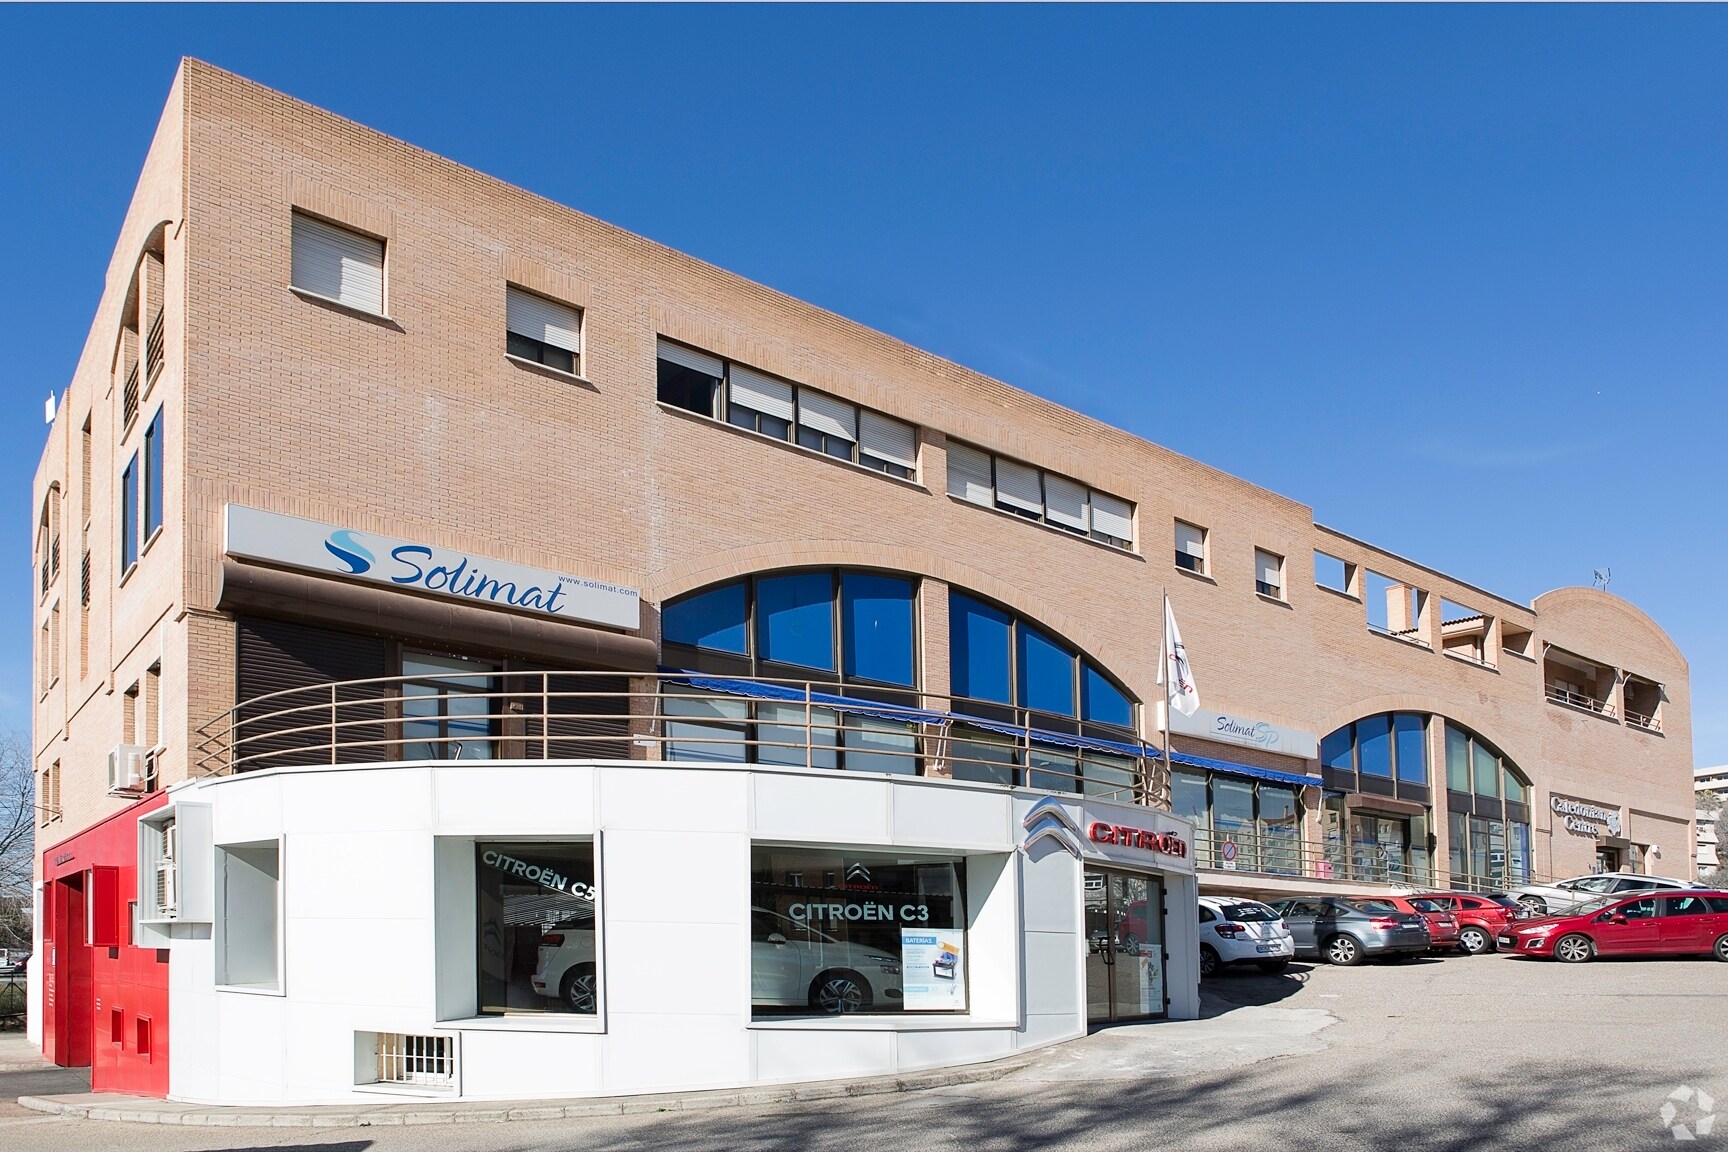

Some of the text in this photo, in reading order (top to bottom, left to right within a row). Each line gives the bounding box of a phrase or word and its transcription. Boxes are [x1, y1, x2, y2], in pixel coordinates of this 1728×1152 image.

[391, 545, 567, 613] Solimat
[558, 576, 638, 597] www.solimat.com
[1217, 716, 1256, 738] Solimat
[482, 850, 596, 901] CITROËN C5
[788, 901, 929, 921] CITROËN C3
[905, 936, 933, 944] BATERÍAS
